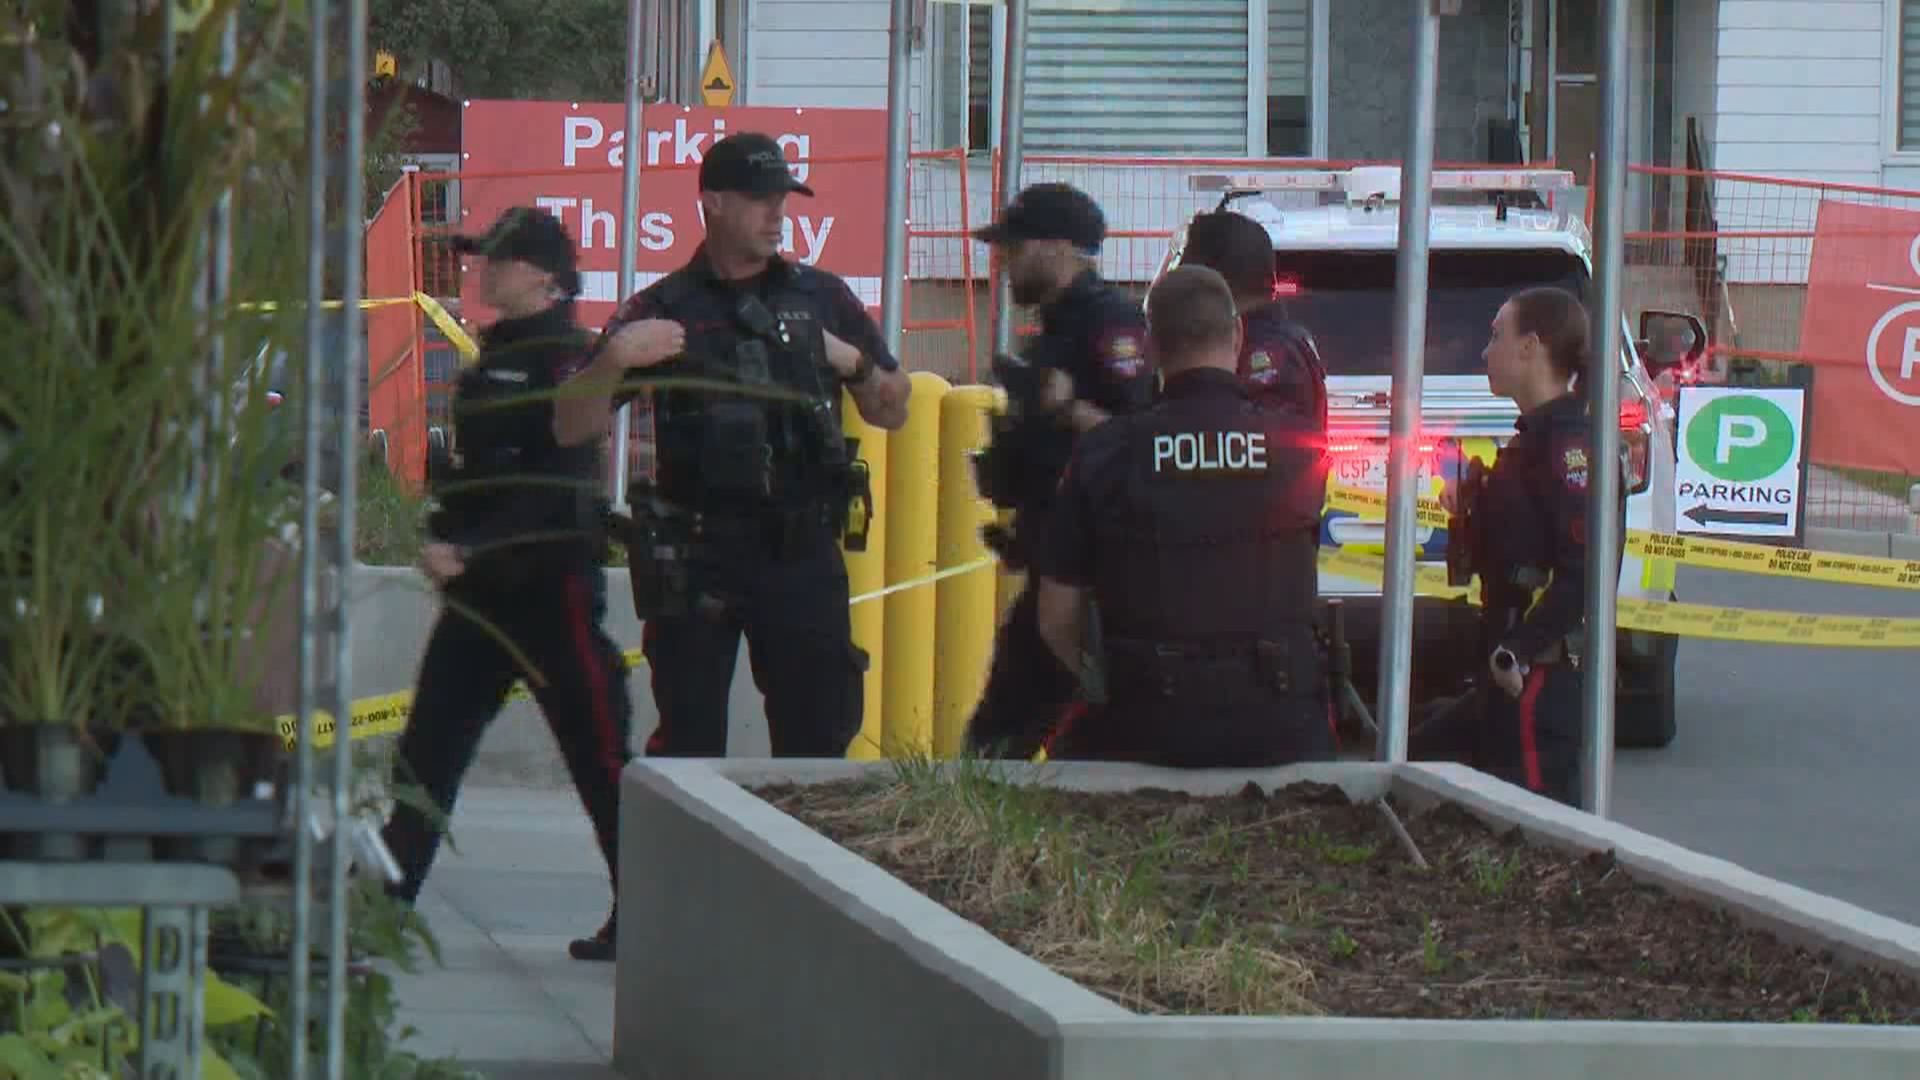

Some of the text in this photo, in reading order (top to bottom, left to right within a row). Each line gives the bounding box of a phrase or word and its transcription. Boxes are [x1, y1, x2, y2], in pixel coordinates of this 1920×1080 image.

[536, 196, 675, 251] Ths
[1153, 431, 1267, 472] POLICE
[1679, 482, 1792, 504] PARKING
[1665, 547, 1685, 559] CROSS
[1791, 562, 1812, 573] CROSS
